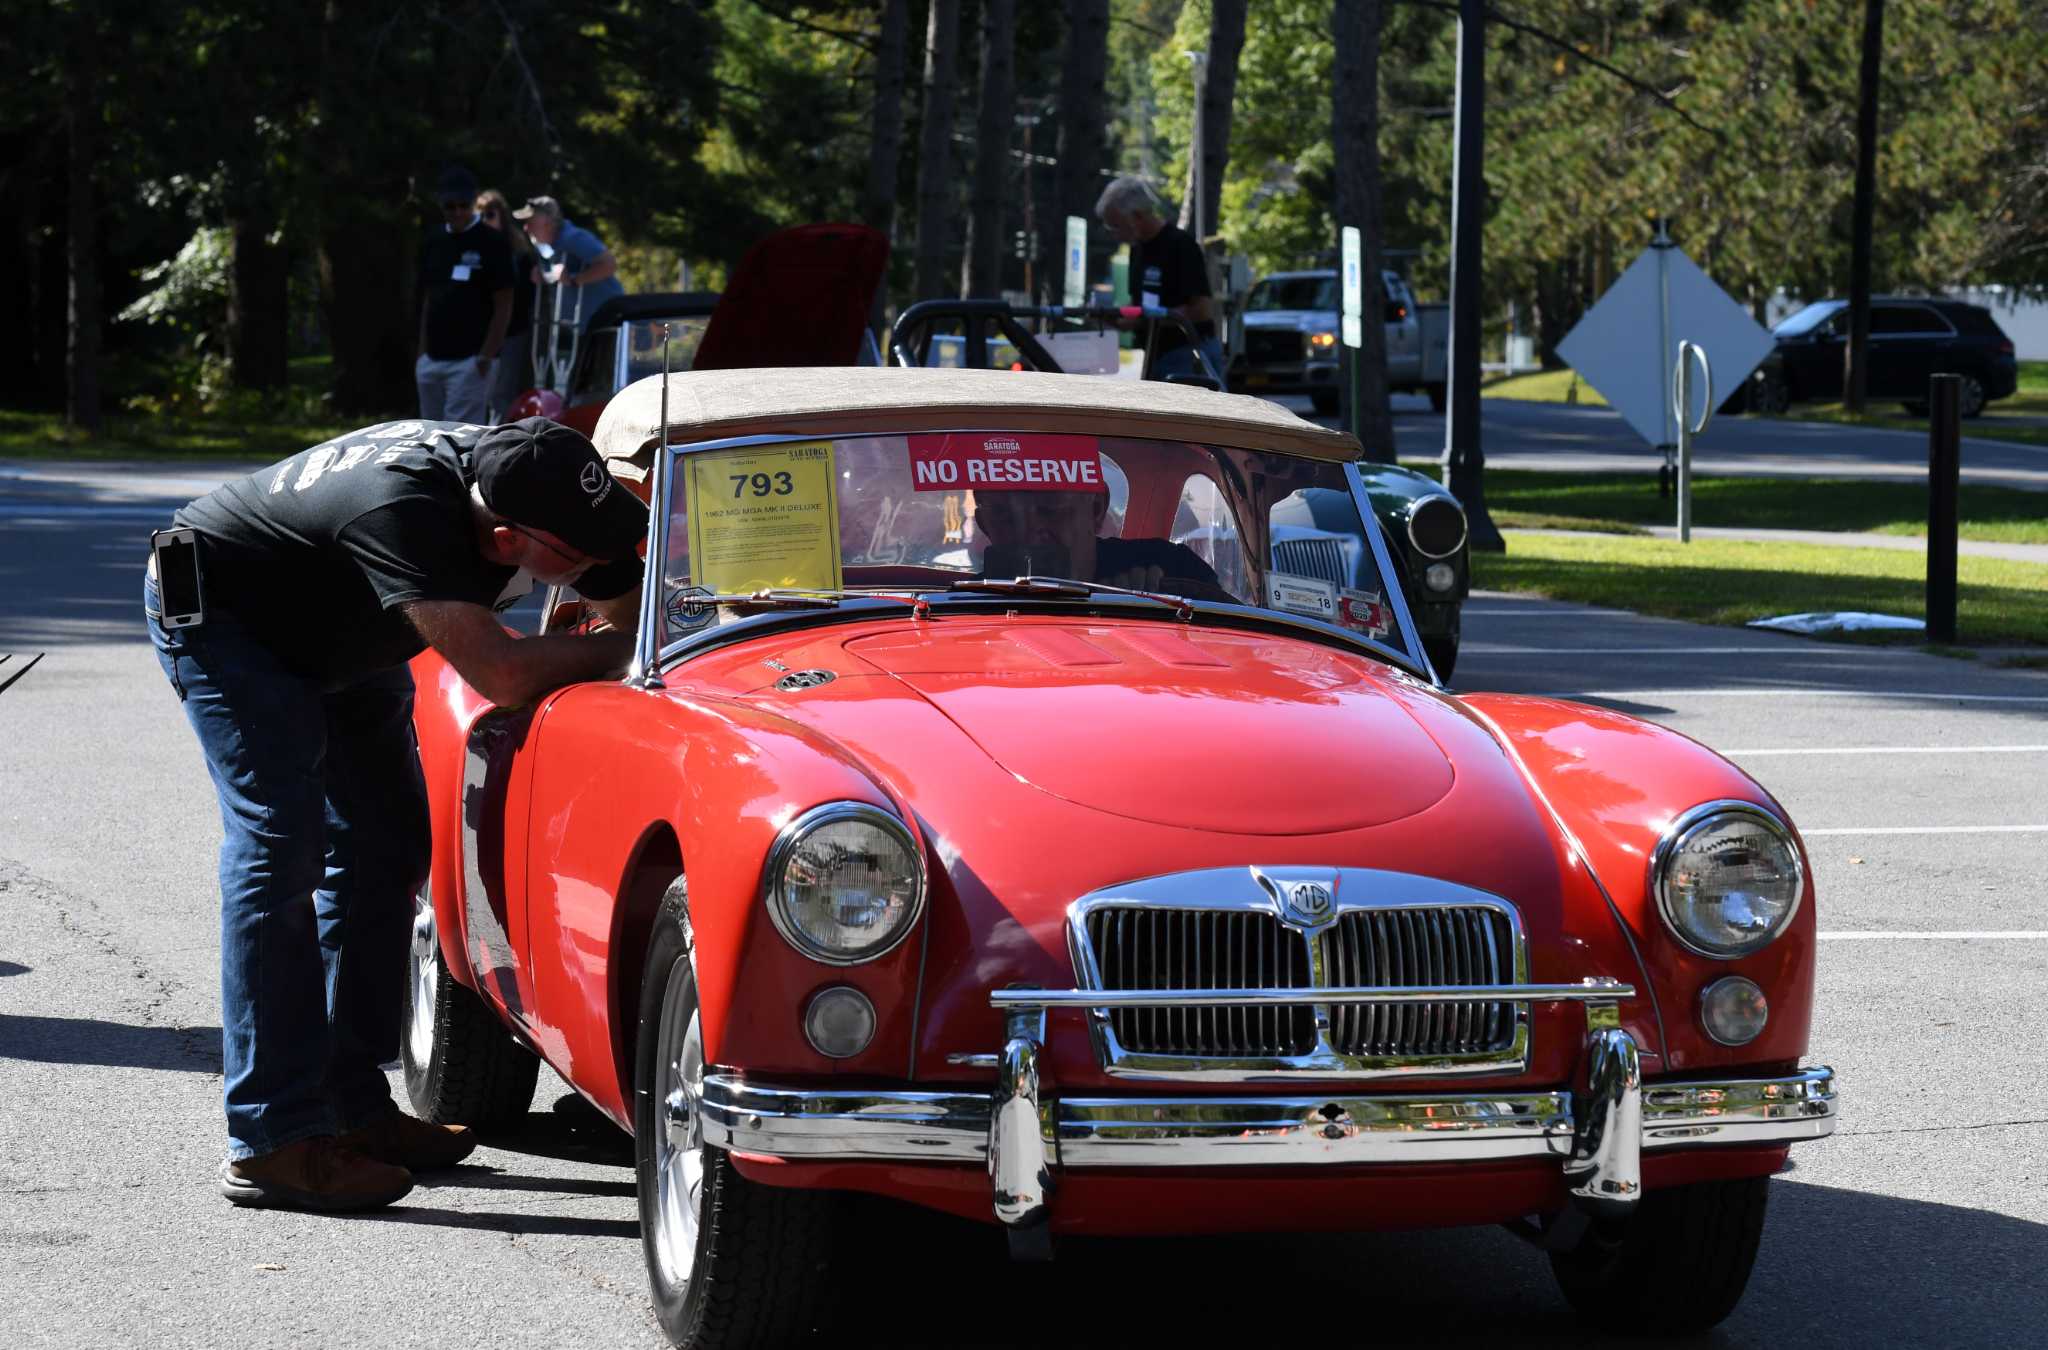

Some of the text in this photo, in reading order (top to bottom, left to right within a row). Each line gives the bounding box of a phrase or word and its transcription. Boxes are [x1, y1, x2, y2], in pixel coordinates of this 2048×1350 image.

[984, 441, 1021, 451] SARATOGA
[916, 459, 1098, 484] NO RESERVE
[729, 471, 794, 499] 793
[705, 510, 725, 518] 1962
[787, 503, 821, 512] DELUXE
[1273, 590, 1281, 600] 9
[1318, 597, 1331, 609] 18
[1294, 884, 1326, 910] MG
